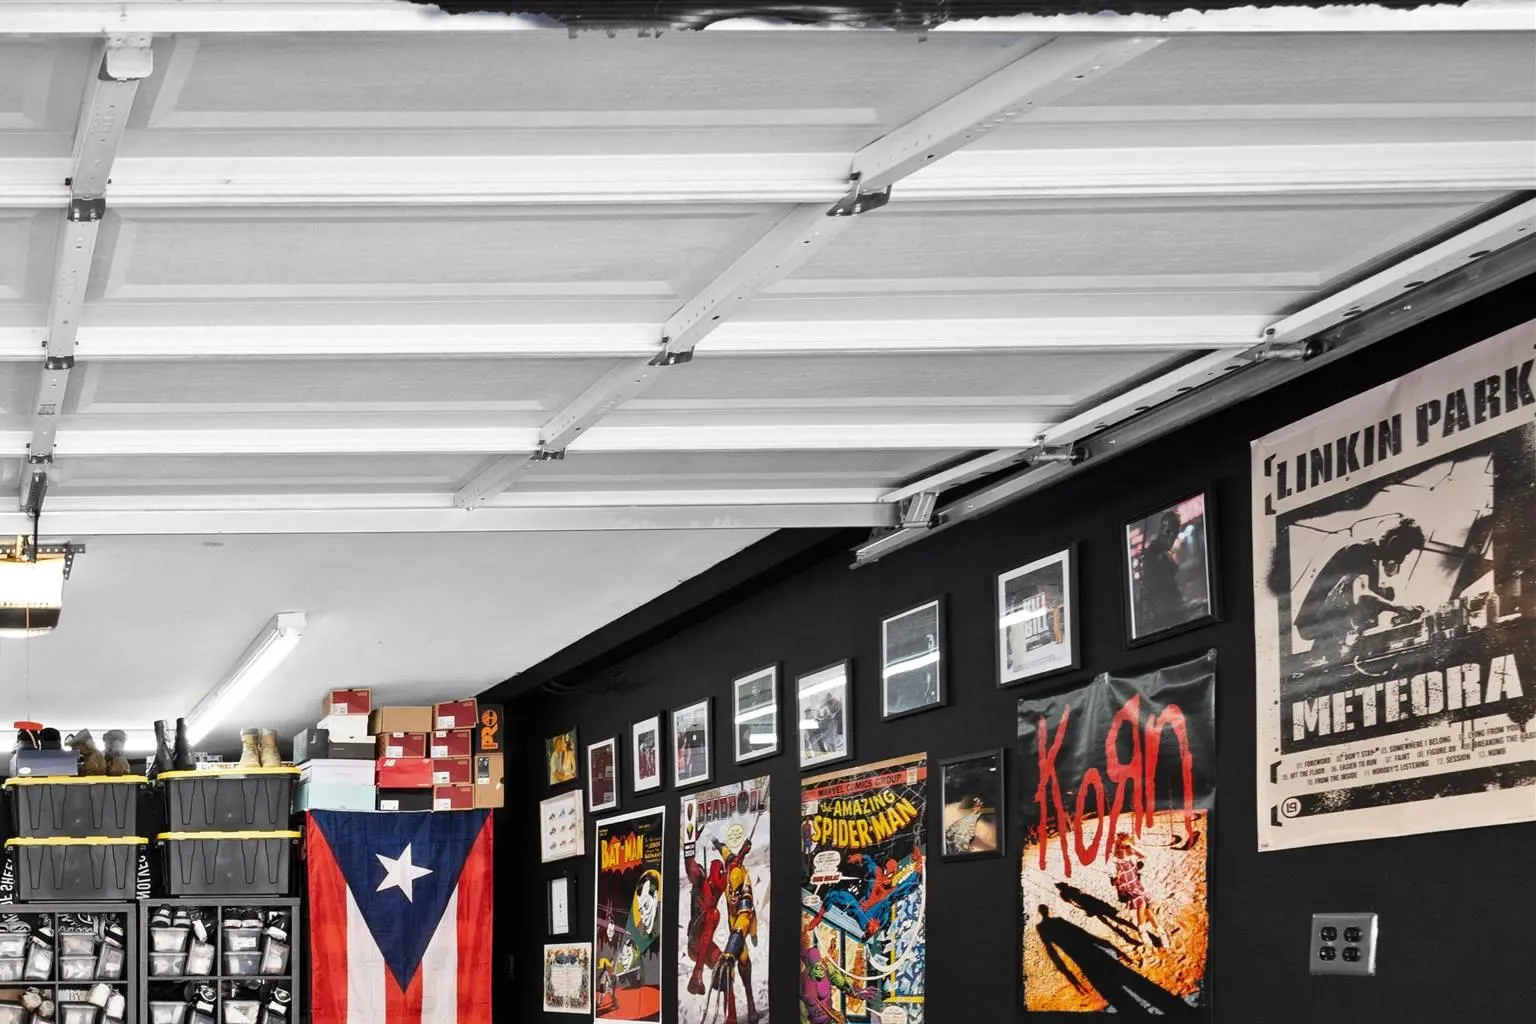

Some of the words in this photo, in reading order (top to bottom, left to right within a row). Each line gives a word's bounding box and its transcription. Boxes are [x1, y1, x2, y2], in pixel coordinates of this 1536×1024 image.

[1277, 414, 1402, 500] LINKIN
[1416, 358, 1536, 447] PARK
[1291, 653, 1524, 741] METEORA
[818, 786, 845, 797] MARVEL
[846, 780, 873, 791] COMICS
[874, 774, 902, 786] GROUP
[833, 790, 896, 817] AMAZING
